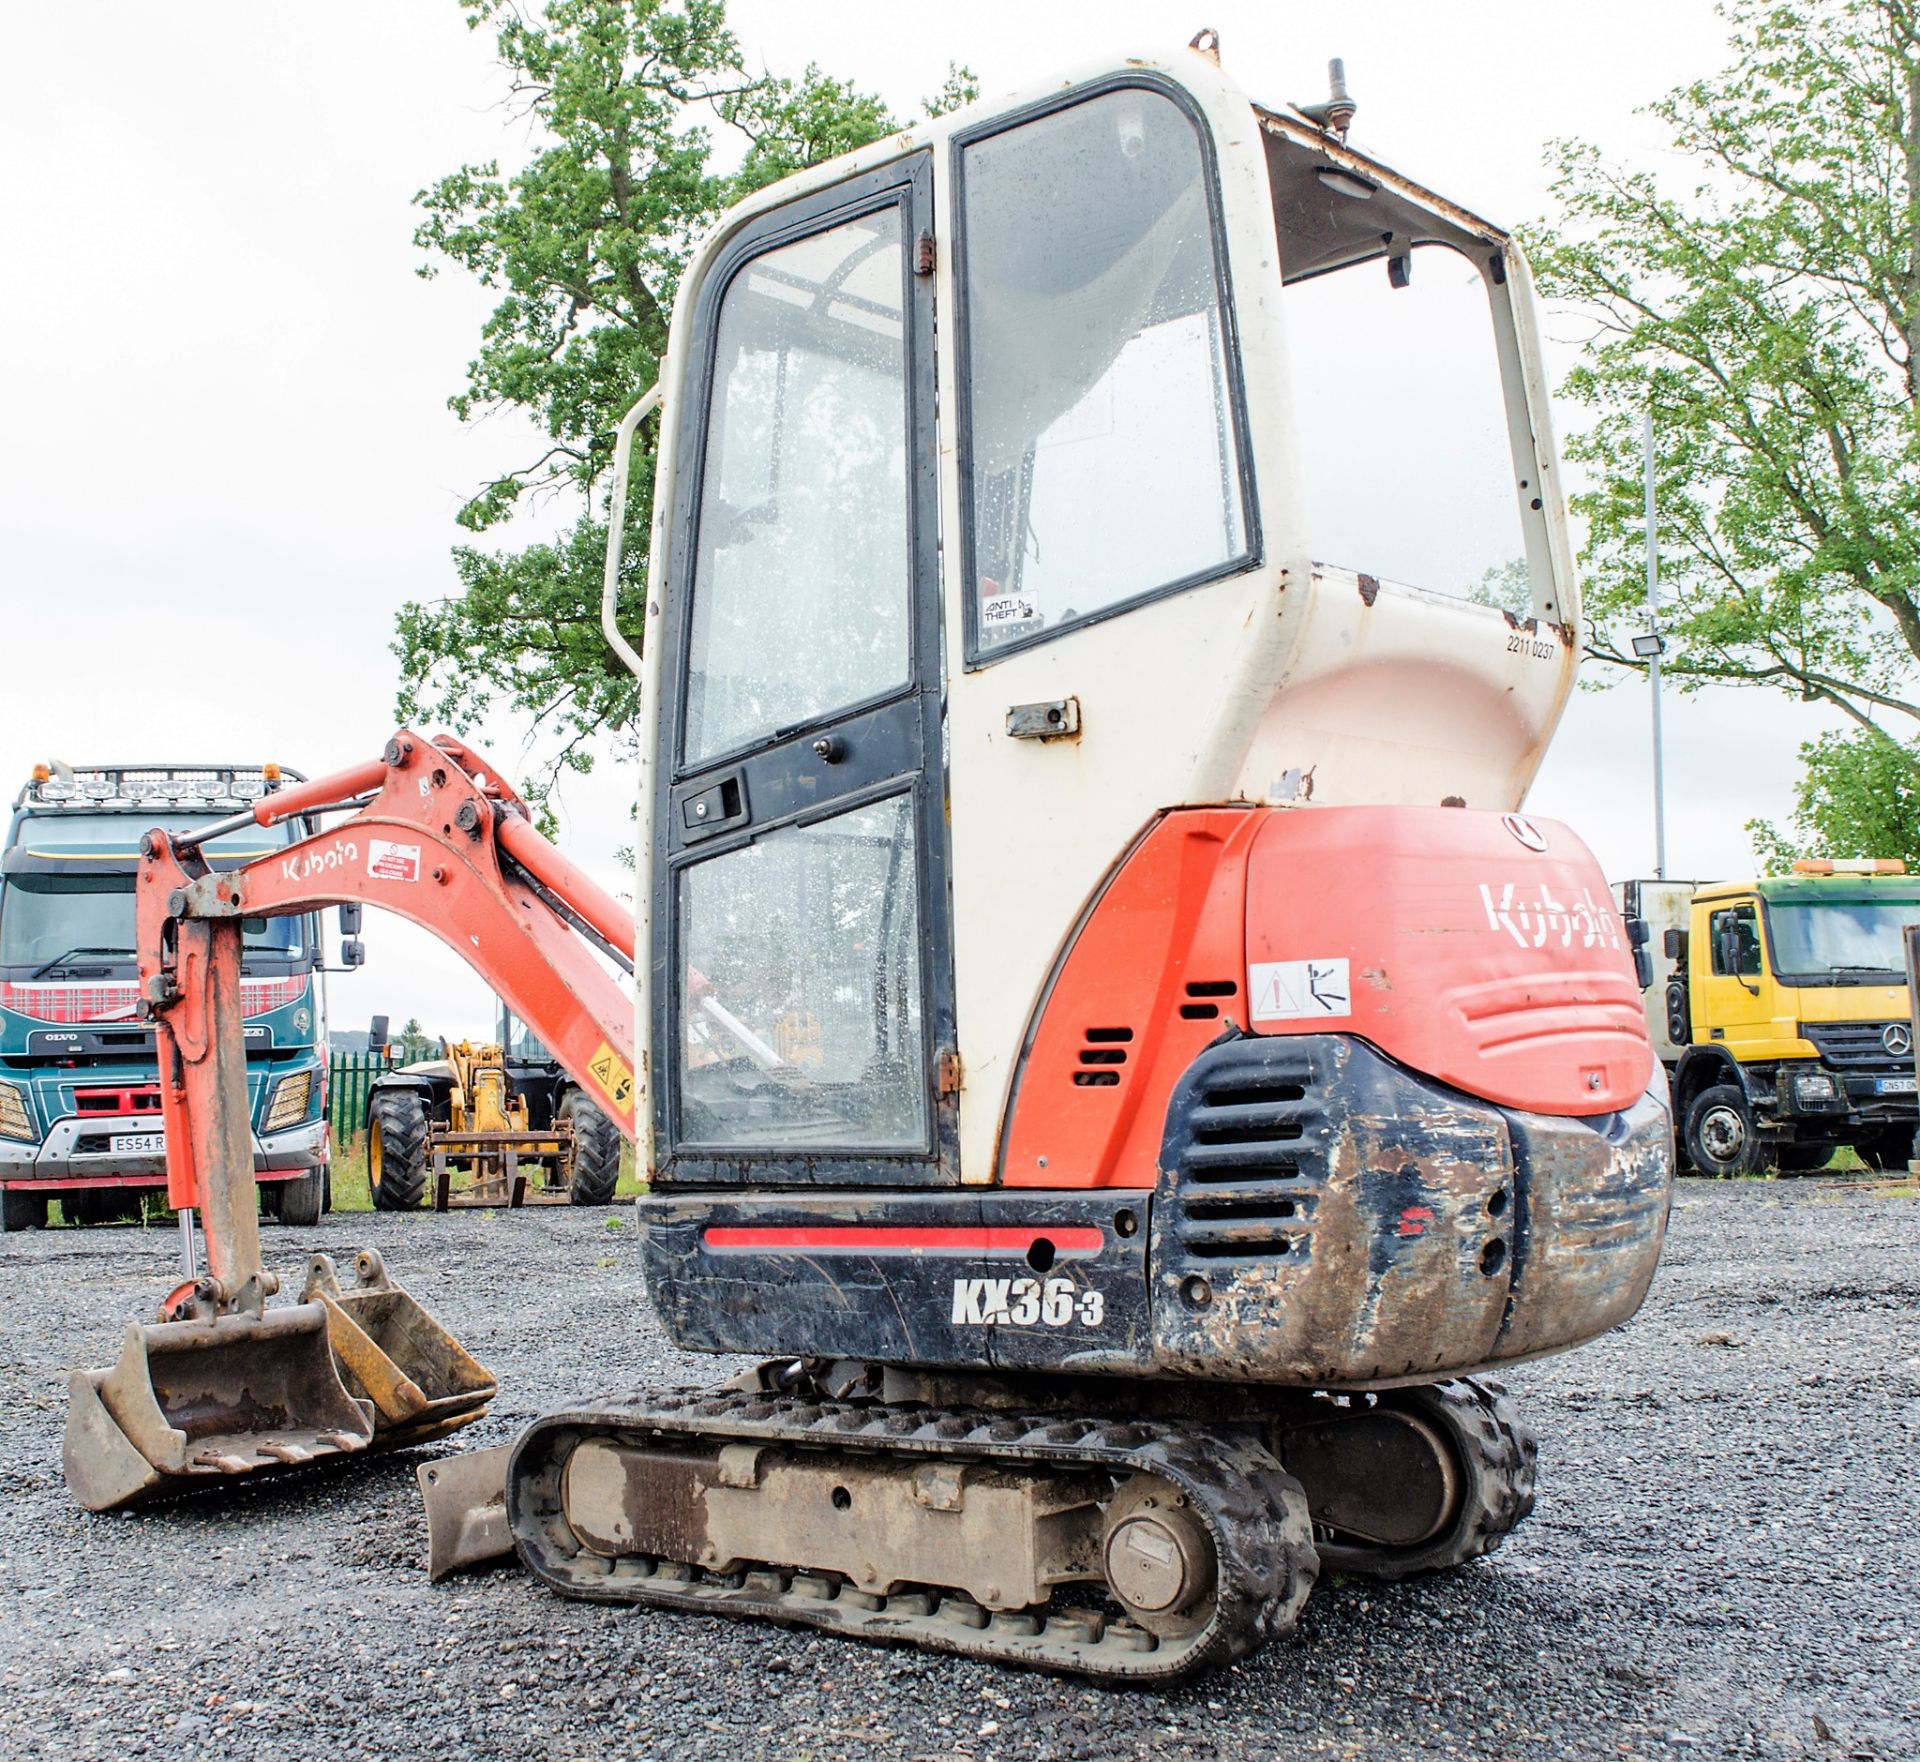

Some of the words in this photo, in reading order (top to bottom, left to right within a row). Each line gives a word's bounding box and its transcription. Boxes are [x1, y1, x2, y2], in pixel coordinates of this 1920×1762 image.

[985, 600, 1012, 612] ANTI
[985, 608, 1017, 621] THEFT
[1507, 635, 1529, 655] 2211
[1532, 640, 1554, 660] 0237
[282, 840, 358, 881] Kubota
[116, 1138, 151, 1151] ES54
[951, 1278, 1105, 1327] KX36-3
